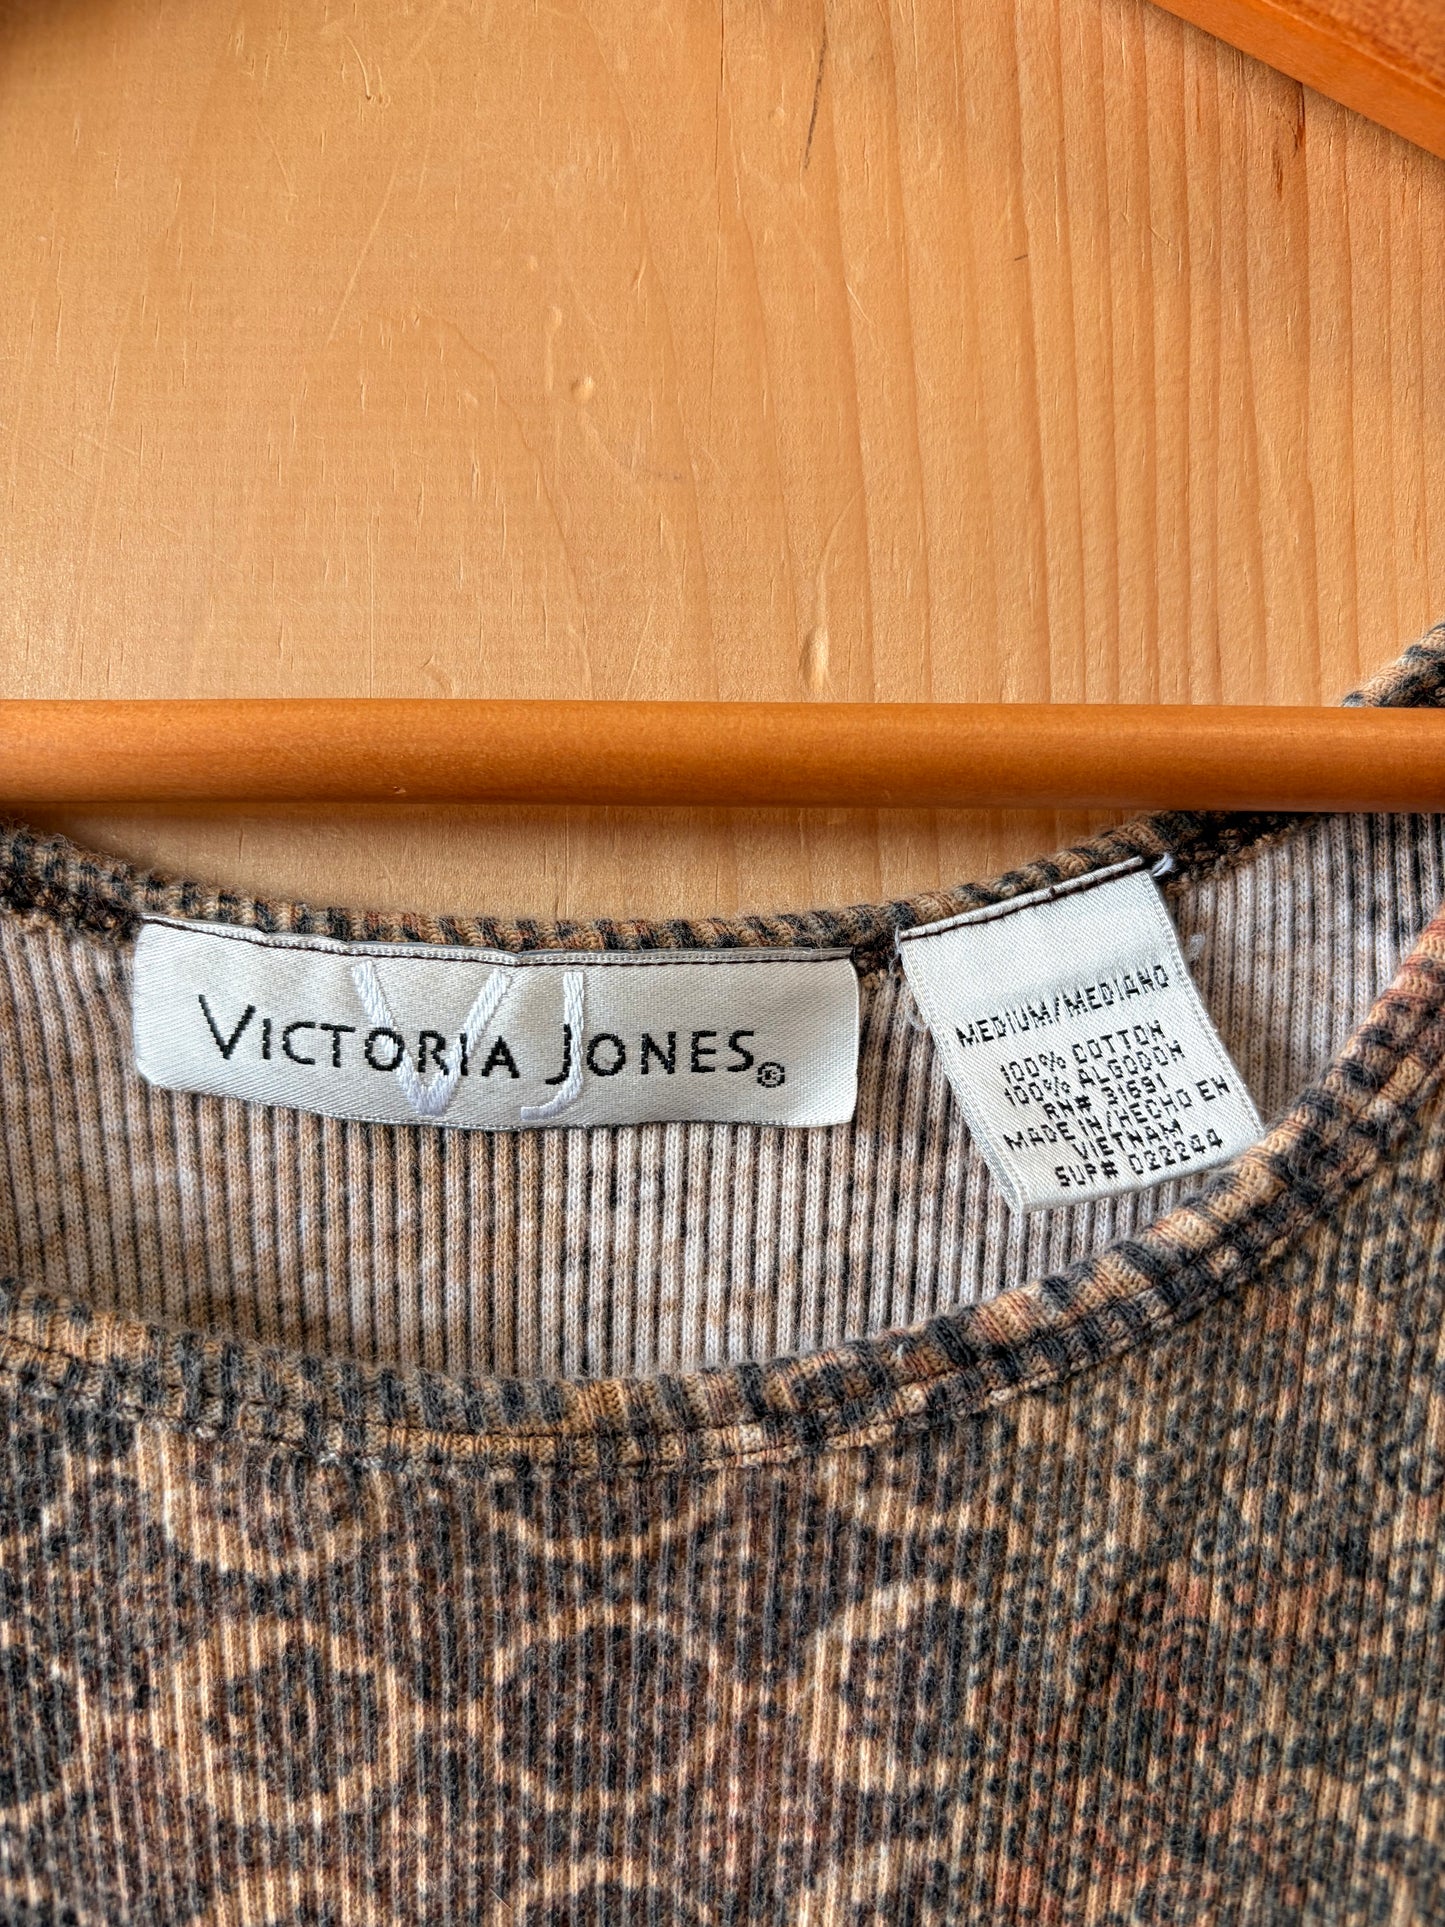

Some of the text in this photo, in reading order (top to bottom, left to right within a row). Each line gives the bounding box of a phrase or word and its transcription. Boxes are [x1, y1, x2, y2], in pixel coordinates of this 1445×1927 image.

[199, 994, 520, 1079] VICTORIA
[955, 964, 1169, 1048] MEDIUM/MEDIANO
[1000, 1020, 1167, 1084] 100% COTTON
[1004, 1039, 1186, 1106] 100% ALGODON
[1003, 1075, 1230, 1152] MADE IN/HECHO EN
[1043, 1073, 1167, 1120] RN# 31691
[1055, 1128, 1223, 1187] SUP# 022244
[1072, 1118, 1184, 1160] VIETNAM
